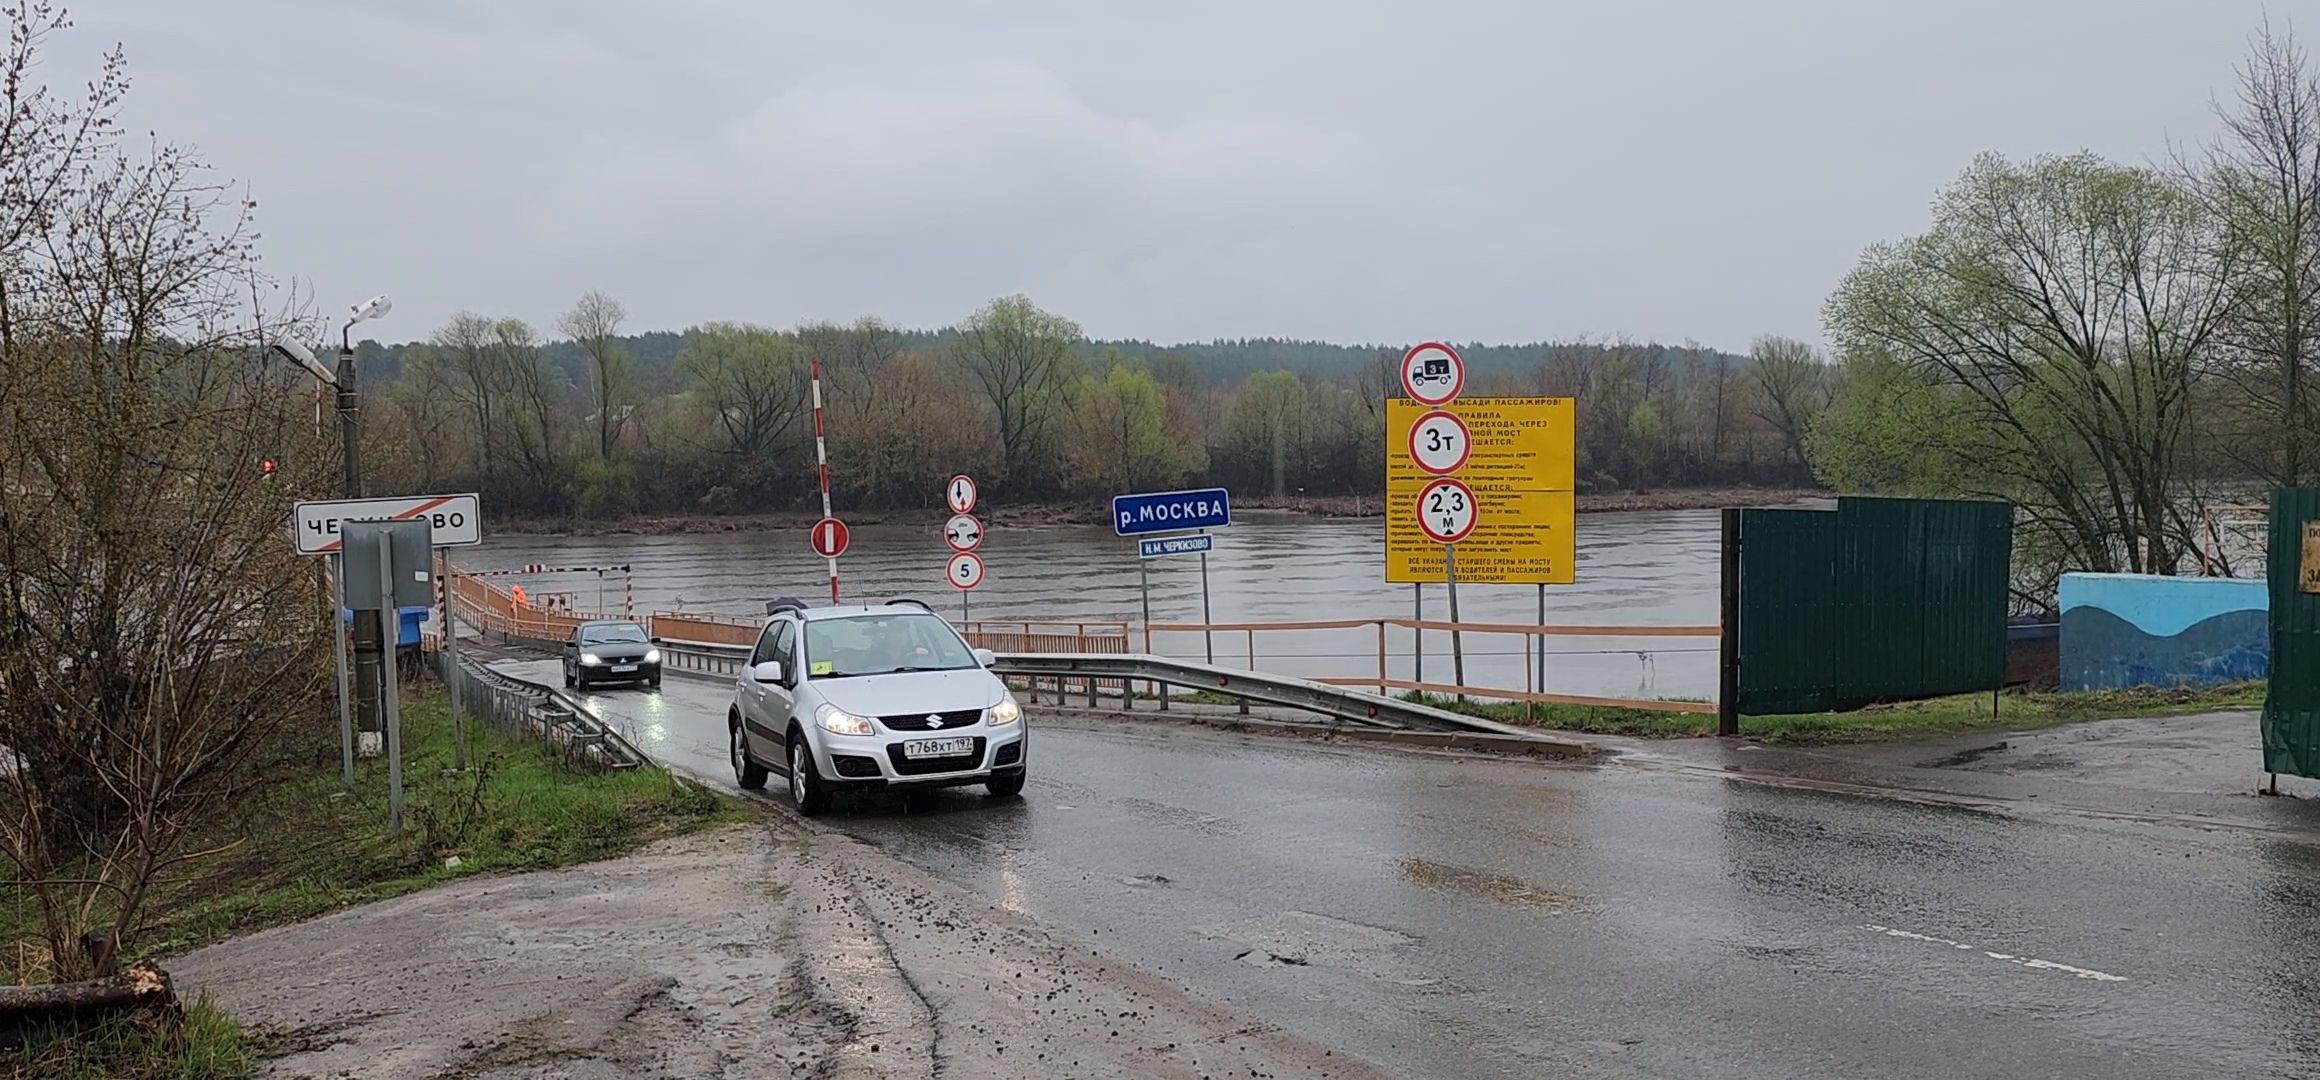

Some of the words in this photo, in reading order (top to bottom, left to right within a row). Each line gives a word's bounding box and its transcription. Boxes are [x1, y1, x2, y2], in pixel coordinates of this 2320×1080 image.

[1471, 438, 1515, 446] ЕШАЕТСЯ:
[1430, 492, 1464, 516] 2,3
[1163, 538, 1209, 552] ЧЕРКИЗОВО
[1408, 557, 1420, 565] ВСЕ
[960, 563, 970, 578] 5
[1461, 565, 1498, 574] ВОДИТЕЛЕЙ
[1506, 566, 1551, 574] ПАССАЖИРОВ
[908, 741, 952, 754] Т768ХТ
[955, 739, 971, 748] 197
